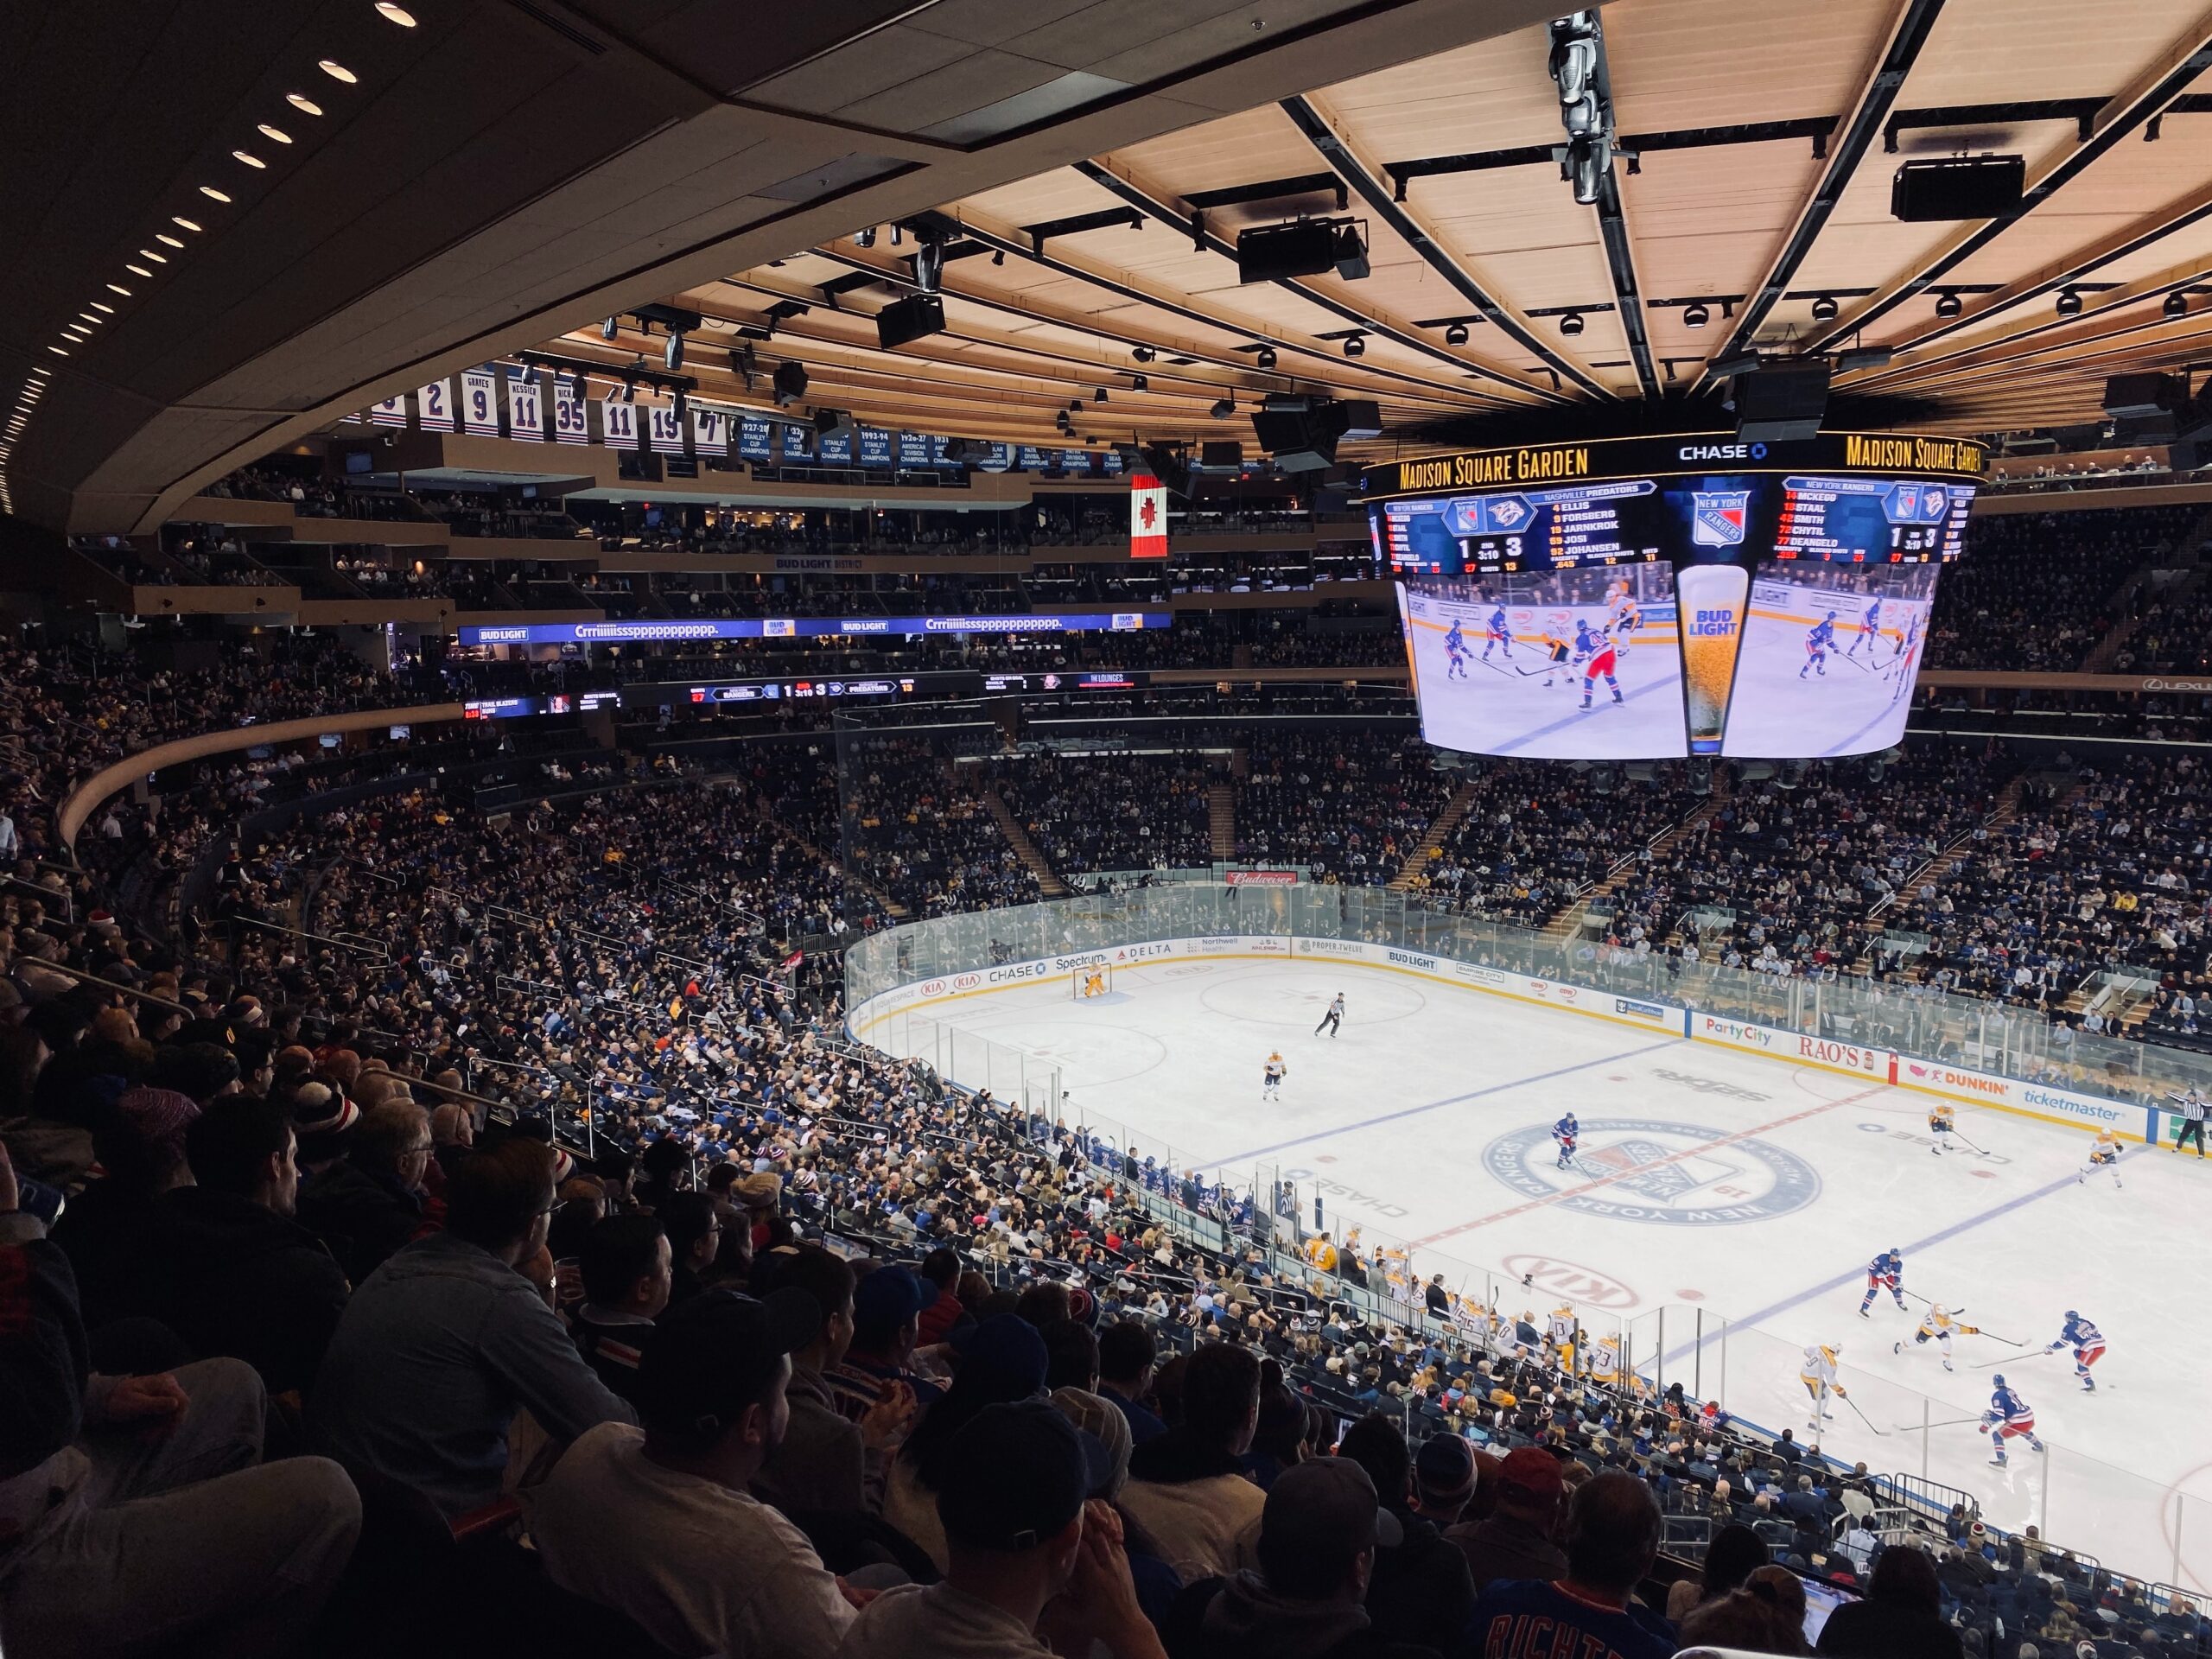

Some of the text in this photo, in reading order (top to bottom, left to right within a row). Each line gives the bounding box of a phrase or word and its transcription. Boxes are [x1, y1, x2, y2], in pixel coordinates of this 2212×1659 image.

[467, 378, 489, 388] GRAVES
[512, 385, 537, 396] MESSIER
[427, 385, 443, 416] 2
[473, 391, 487, 421] 9
[514, 397, 537, 428] 11
[557, 400, 585, 431] 35
[609, 406, 632, 435] 11
[653, 410, 678, 439] 19
[702, 414, 716, 442] 7
[861, 432, 888, 442] 1993-94
[741, 447, 770, 455] CHAMPIONS
[1680, 445, 1747, 461] CHASE
[1847, 435, 1981, 473] MADISON SQUARE GARDEN
[1400, 461, 1452, 490] MADISON
[1455, 455, 1512, 486] SQUARE
[1518, 448, 1588, 479] GARDEN
[1806, 480, 1823, 489] NEW
[1544, 485, 1639, 501] NASHVILLE PREDATORS
[1797, 492, 1837, 502] MCKEGG
[1561, 501, 1590, 512] ELLIS
[1699, 499, 1744, 508] NEW YORK
[1796, 503, 1827, 513] STAAL
[1562, 510, 1616, 523] FORSBERG
[1780, 513, 1825, 524] 42 SMITH
[1550, 520, 1620, 534] 19 JARNKROK
[1705, 512, 1739, 539] RANGERS
[1779, 524, 1826, 536] 72 CHYTIL
[1564, 535, 1588, 543] JOSI
[1777, 537, 1838, 547] 77 DEANGELO
[1891, 527, 1936, 548] 1 3
[1459, 539, 1469, 559] 1
[1505, 537, 1522, 556] 3
[1565, 543, 1620, 555] JOHANSEN
[1478, 550, 1499, 560] 3:10
[776, 559, 798, 569] BUD
[801, 559, 831, 569] LIGHT
[1465, 563, 1477, 572] 27
[1504, 562, 1516, 571] 13
[1696, 610, 1733, 623] BUD
[861, 622, 887, 631] LIGHT
[1689, 622, 1738, 636] LIGHT
[480, 630, 526, 640] BUD LIGHT
[784, 685, 791, 697] 1
[795, 689, 813, 697] 3:10
[816, 683, 826, 696] 3
[2164, 682, 2212, 690] LEXU
[692, 694, 705, 702] 27
[723, 690, 755, 699] RANGERS
[1230, 872, 1293, 885] Budweiser
[1129, 944, 1172, 957] DELTA
[1312, 941, 1338, 950] PROPER
[1339, 944, 1363, 954] TWELVE
[1056, 953, 1104, 971] Spectrum
[1389, 951, 1436, 969] BUD LIGHT
[989, 965, 1033, 982] CHASE
[1459, 966, 1502, 980] EMPIRE CITY
[957, 975, 977, 987] KIA
[925, 982, 943, 995] KIA
[1799, 1036, 1859, 1067] RAO'S
[2024, 1090, 2120, 1121] ticketmaster
[1494, 1141, 1554, 1194] RANGERS
[1308, 1178, 1409, 1219] CHASE
[1565, 1197, 1669, 1222] YORK
[1687, 1205, 1764, 1222] NEW
[1523, 1258, 1622, 1304] KIA
[1499, 1325, 1511, 1338] 8
[1485, 1613, 1622, 1659] RICHT
